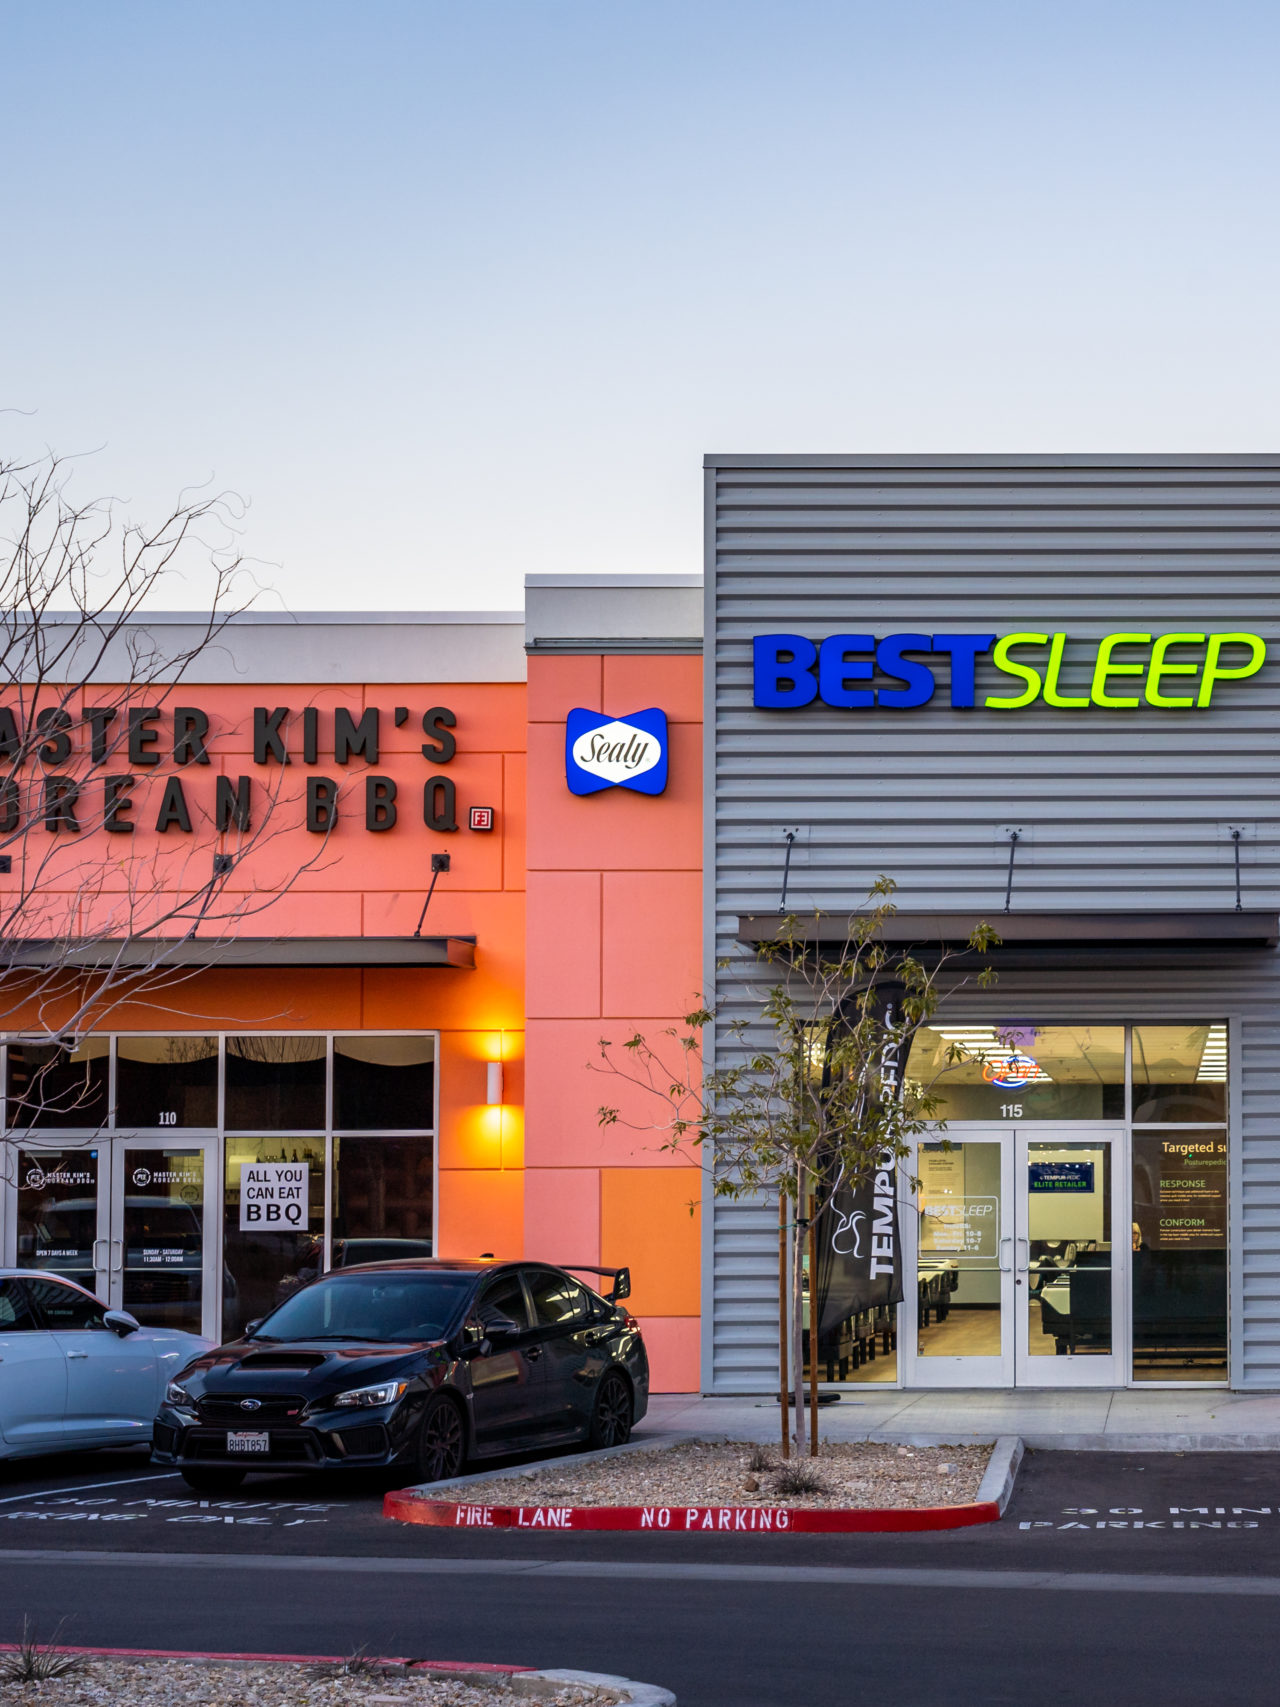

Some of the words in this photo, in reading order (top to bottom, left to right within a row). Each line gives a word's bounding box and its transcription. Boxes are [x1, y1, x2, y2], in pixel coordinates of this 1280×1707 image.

[754, 632, 1267, 709] BESTSLEEP
[253, 706, 457, 765] KIM'S
[580, 733, 649, 769] Sealy
[306, 775, 459, 833] BBQ
[1000, 1104, 1023, 1117] 115
[159, 1111, 177, 1124] 110
[1162, 1141, 1214, 1155] Targeted
[247, 1170, 271, 1182] ALL
[275, 1169, 302, 1182] YOU
[1159, 1179, 1206, 1188] RESPONSE
[247, 1187, 274, 1199] CAN
[279, 1187, 302, 1199] EAT
[246, 1203, 302, 1225] BBQ
[1159, 1218, 1205, 1227] CONFORM
[455, 1505, 494, 1526] FIRE
[517, 1507, 573, 1528] LANE
[640, 1507, 671, 1528] NO
[685, 1508, 790, 1530] PARKING
[1061, 1507, 1144, 1515] 30
[1018, 1520, 1260, 1530] PARKING
